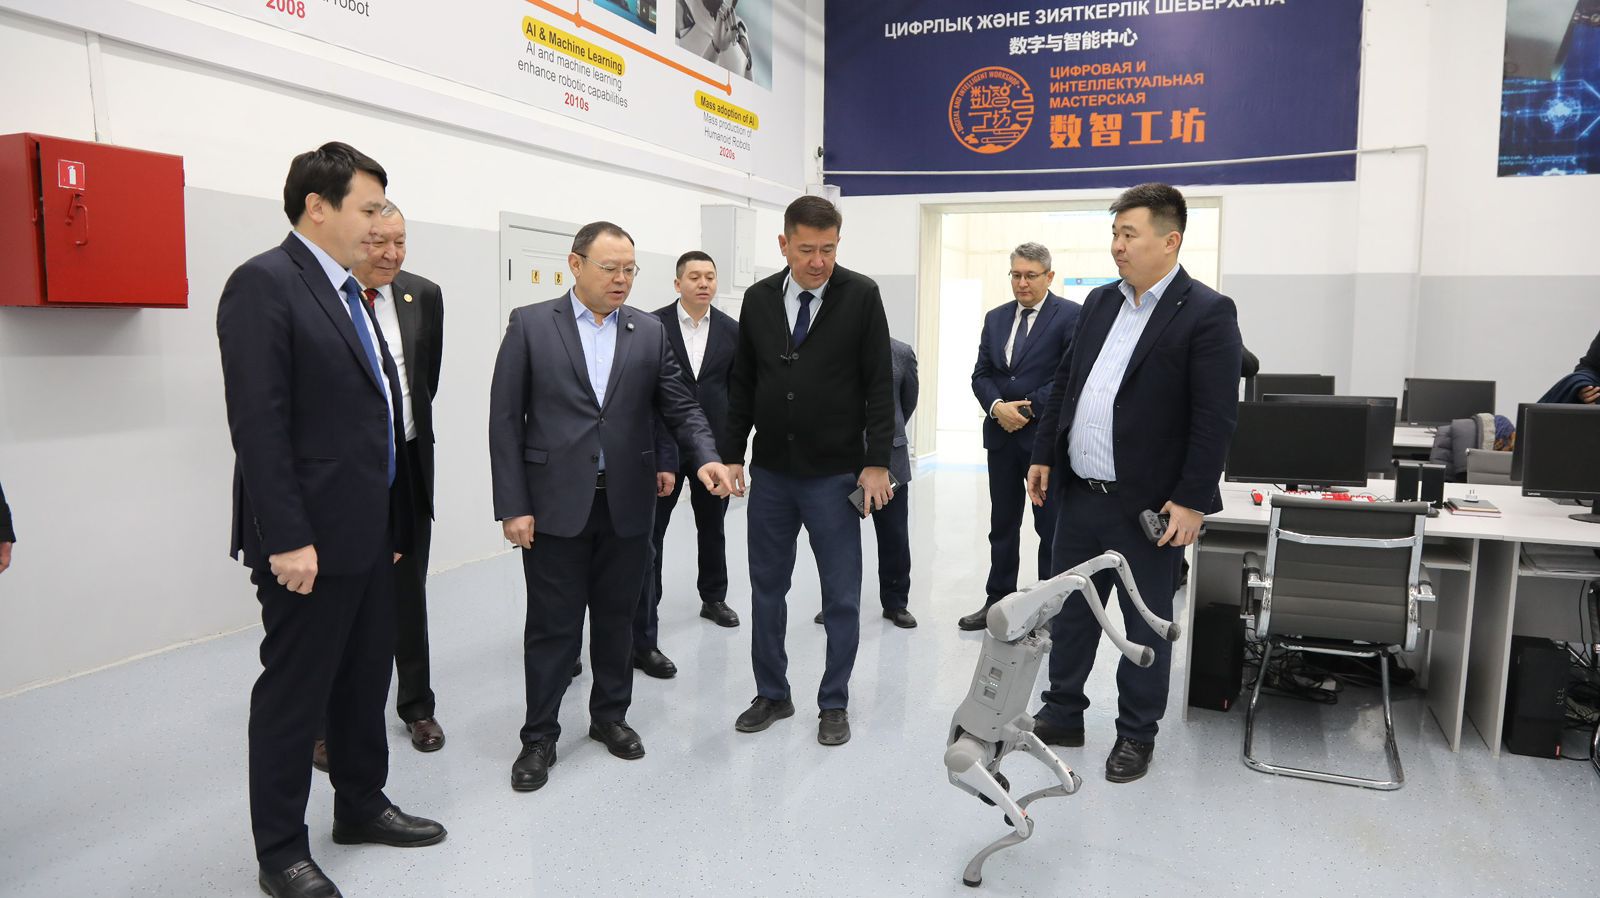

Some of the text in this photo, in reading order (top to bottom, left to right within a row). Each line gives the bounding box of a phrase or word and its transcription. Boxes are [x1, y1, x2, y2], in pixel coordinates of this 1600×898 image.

[884, 15, 973, 40] ЦИФРЛЫҚ
[976, 10, 1030, 30] ЖӘНЕ
[1035, 0, 1150, 25] ЗИЯТКЕРЛІК
[525, 22, 622, 75] AI & Machine Learning
[1008, 27, 1138, 56] 数字与智能中心
[525, 41, 622, 91] AI and machine learning
[1050, 60, 1147, 79] ЦИФРОВАЯ И
[517, 59, 628, 108] enhance robotic capabilities
[1050, 73, 1205, 93] ИНТЕЛЛЕКТУАЛЬНАЯ
[564, 92, 590, 112] 2010s
[700, 95, 716, 110] Mass
[717, 104, 742, 121] adoption
[742, 113, 749, 123] of
[1050, 92, 1147, 108] МАСТЕРСКАЯ
[703, 111, 718, 126] Mass
[719, 119, 746, 135] production
[1050, 107, 1206, 149] 数智工坊
[704, 126, 751, 151] Humanoid Robots
[719, 146, 736, 160] 2020s
